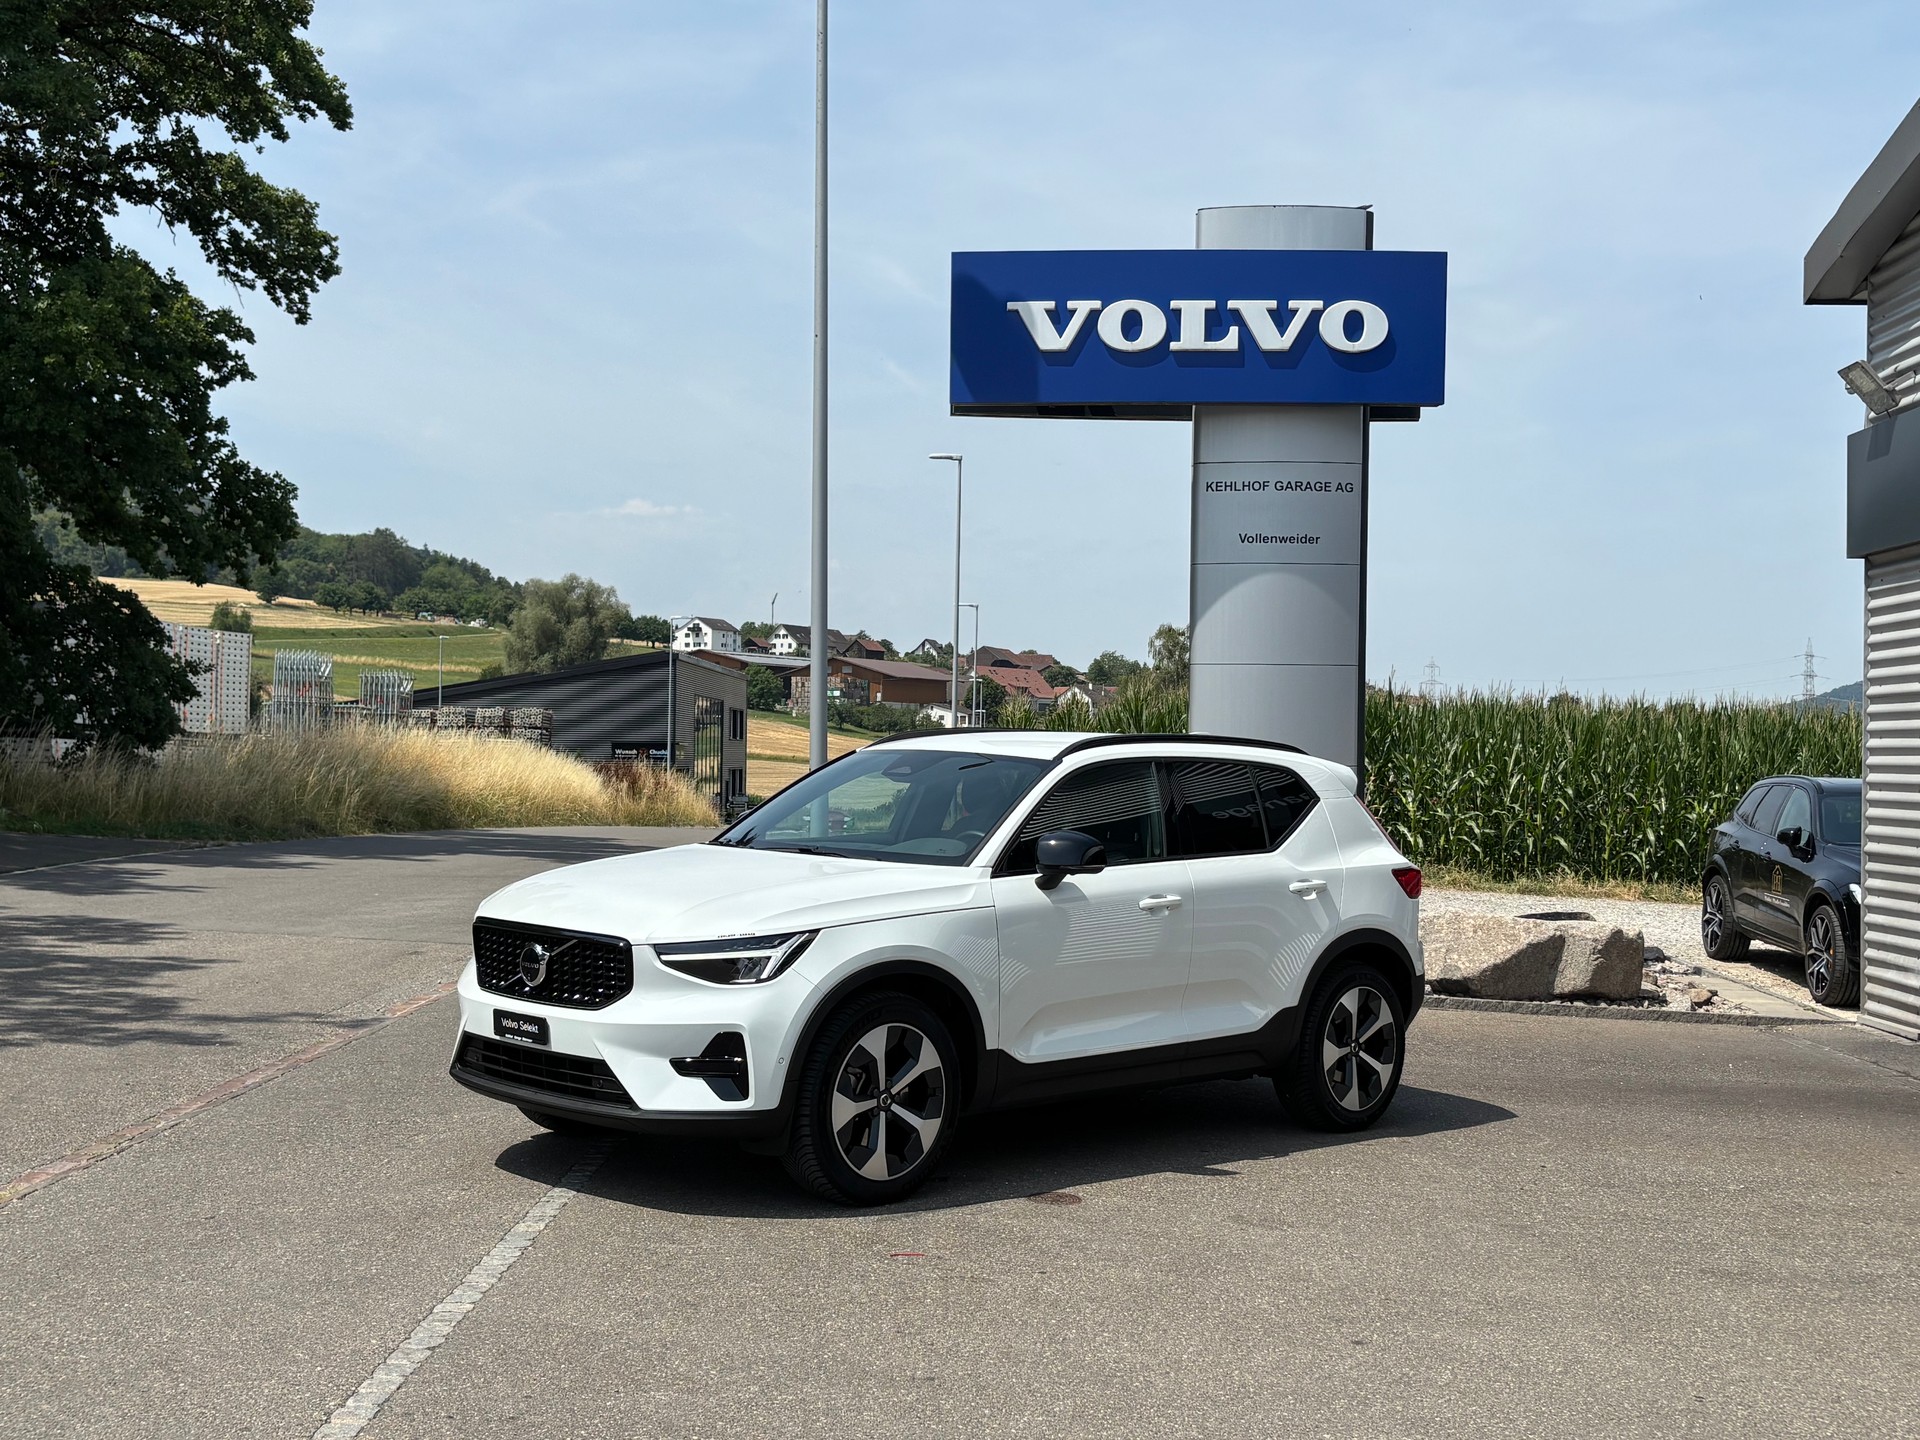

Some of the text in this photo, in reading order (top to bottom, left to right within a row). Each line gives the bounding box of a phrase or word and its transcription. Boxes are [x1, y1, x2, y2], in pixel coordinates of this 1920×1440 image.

[1006, 299, 1389, 354] VOLVO
[1205, 480, 1354, 493] KEHLHOF GARAGE AG
[1238, 533, 1321, 545] Vollenweider
[500, 1017, 539, 1034] Volvo Selekt
